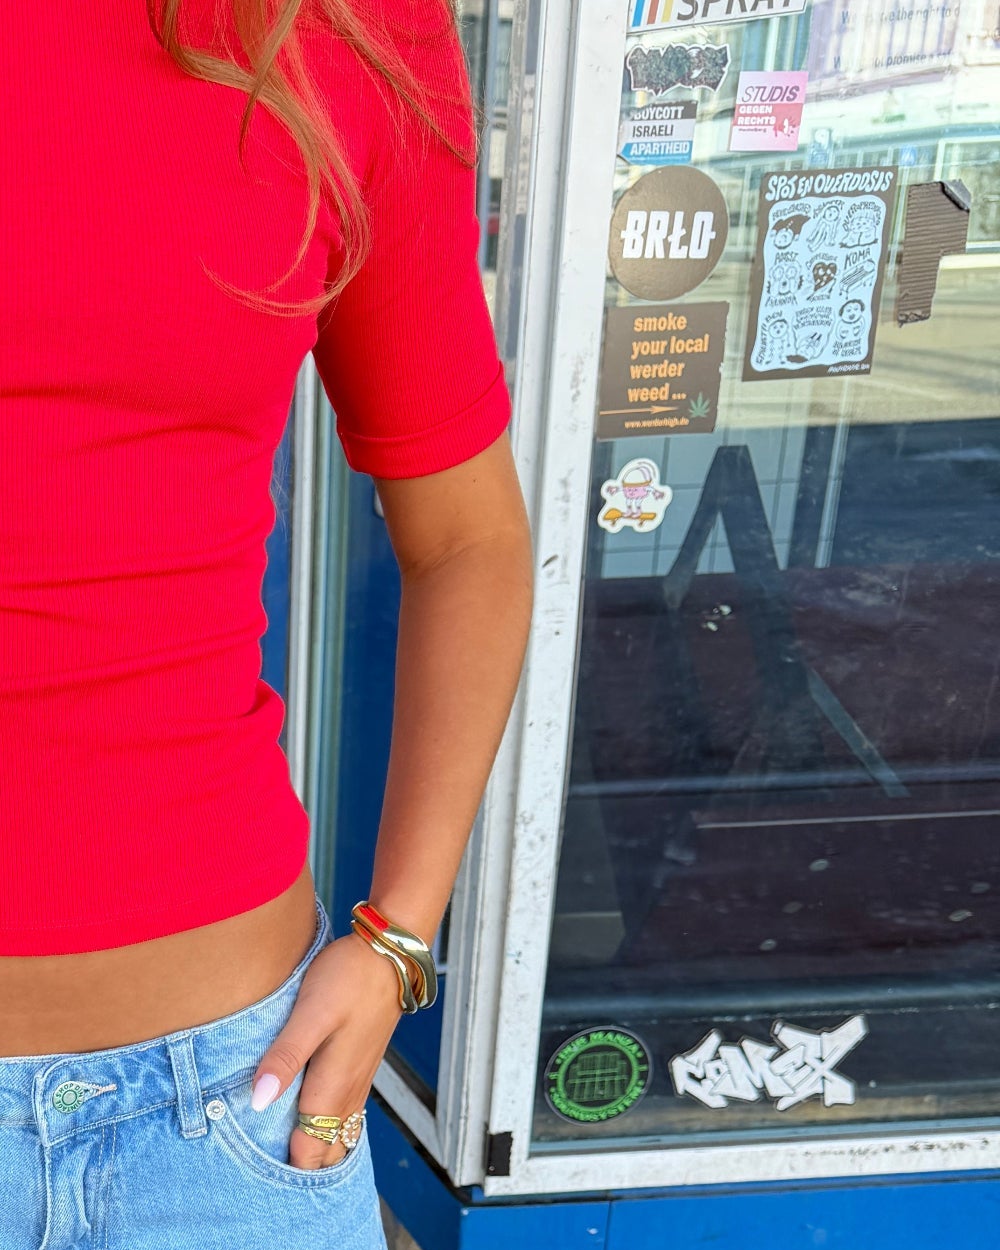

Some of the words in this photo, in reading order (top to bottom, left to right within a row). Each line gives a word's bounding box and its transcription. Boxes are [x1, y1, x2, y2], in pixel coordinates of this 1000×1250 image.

[742, 85, 800, 102] STUDIS
[739, 105, 773, 114] GEGEN
[738, 116, 776, 125] RECHTS
[632, 124, 674, 138] ISRAELI
[630, 141, 690, 156] APARTHEID
[844, 247, 871, 270] KOMA
[633, 312, 688, 332] smoke
[631, 340, 667, 360] your
[669, 333, 710, 354] local
[630, 360, 685, 379] werder
[56, 1083, 73, 1098] SHOP
[56, 1100, 82, 1112] VINTAGE
